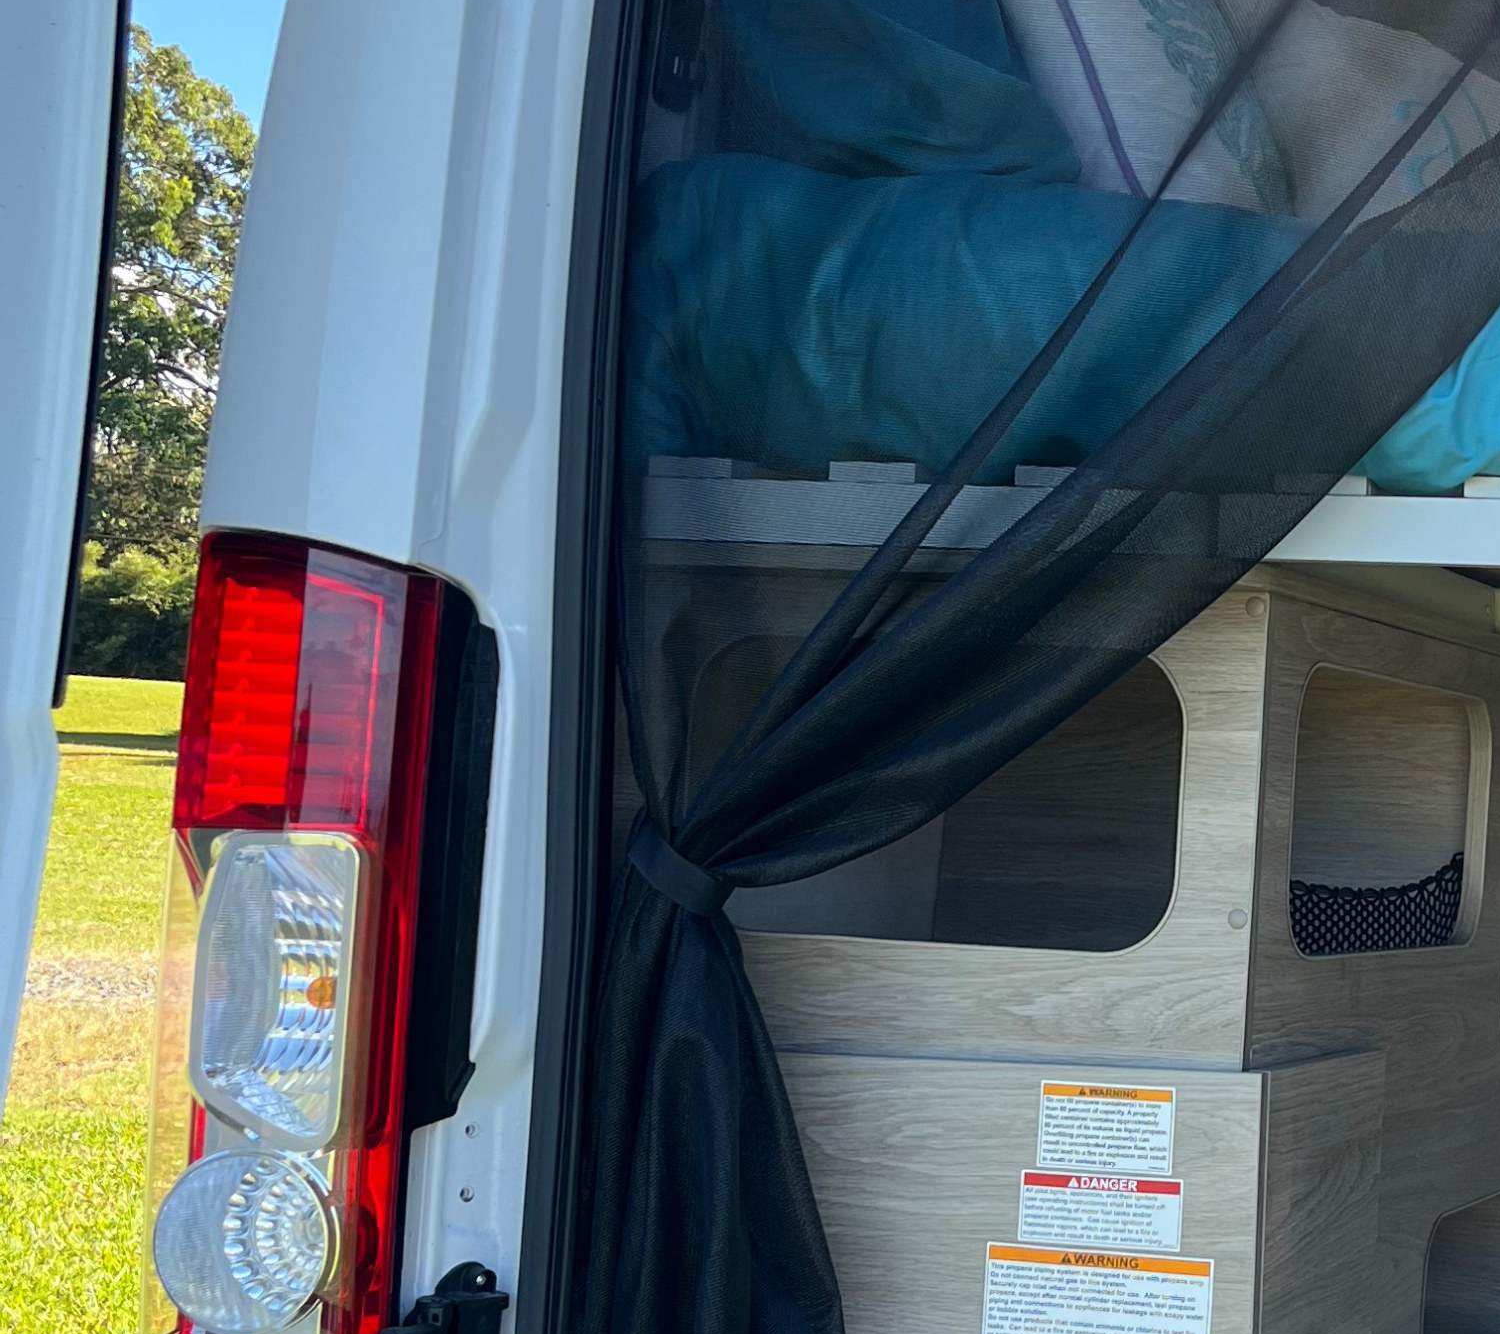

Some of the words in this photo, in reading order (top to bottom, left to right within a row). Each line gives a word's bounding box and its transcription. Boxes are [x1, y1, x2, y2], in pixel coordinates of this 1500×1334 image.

[1089, 1088, 1137, 1098] WARNING
[1080, 1177, 1137, 1191] DANGER
[1073, 1253, 1139, 1269] WARNING
